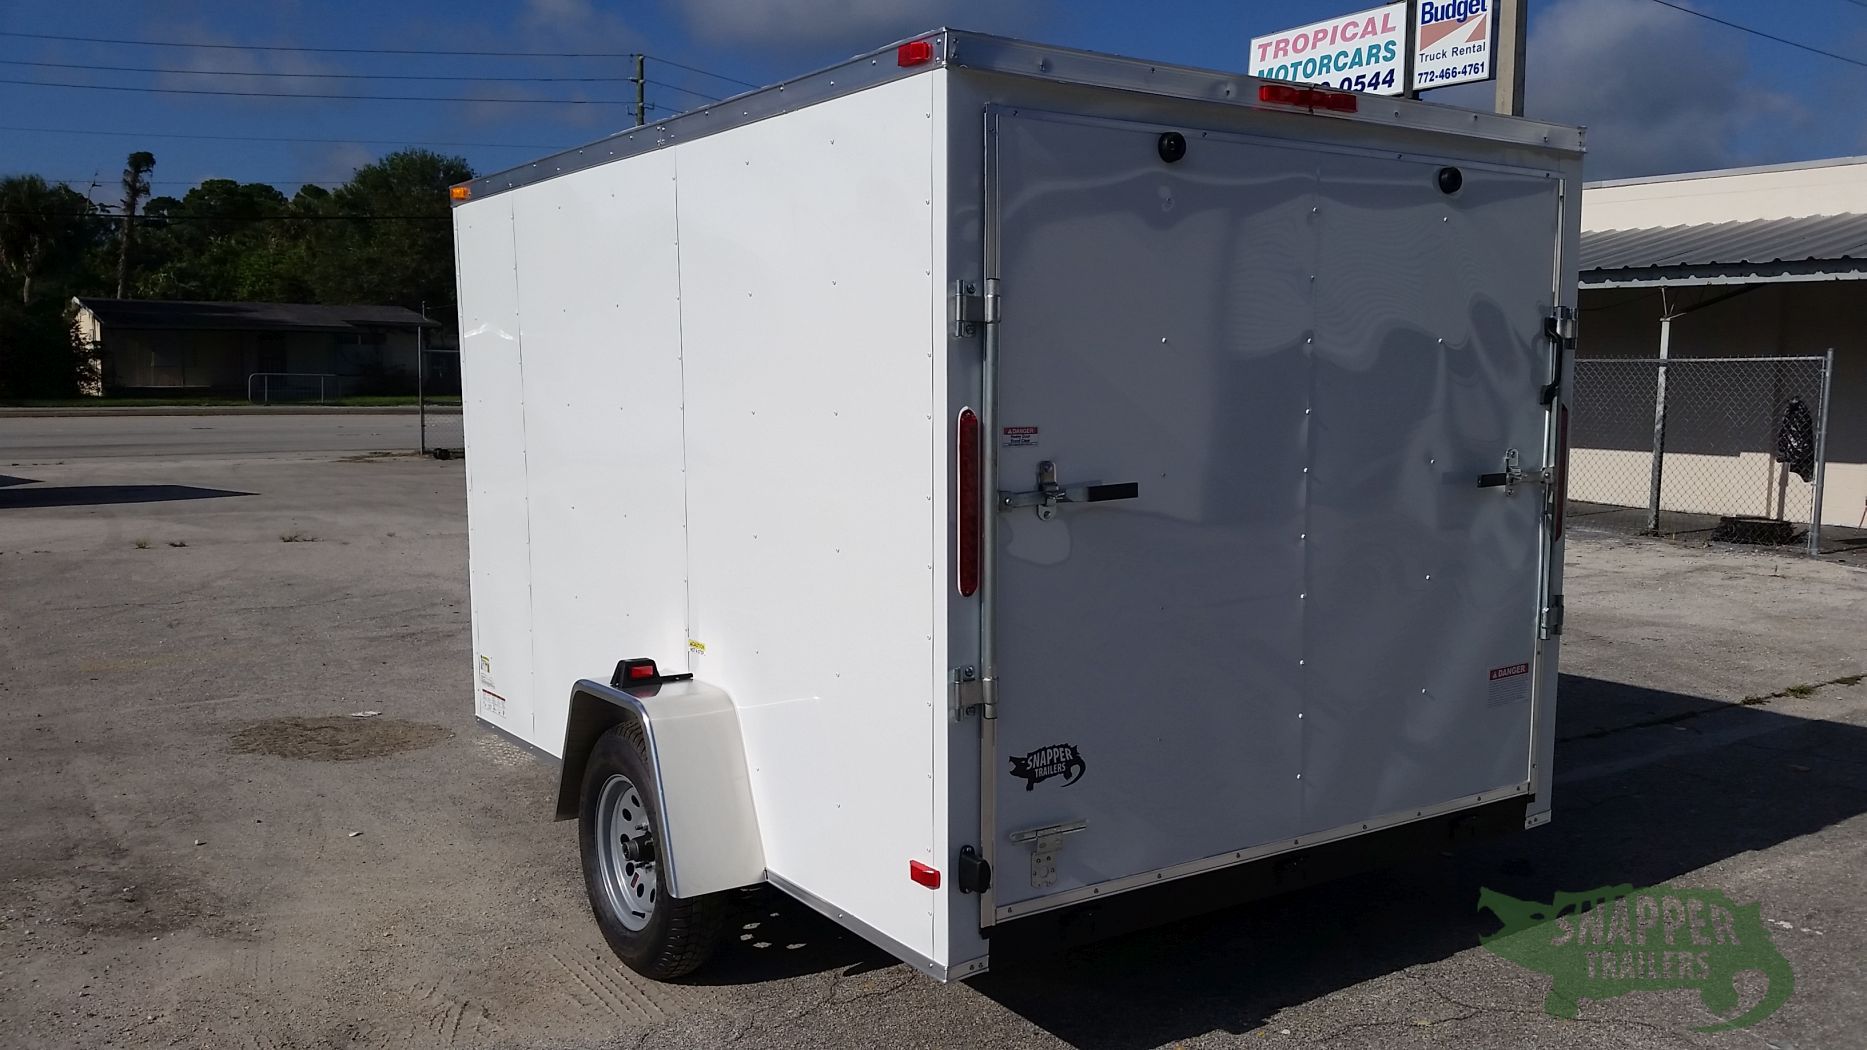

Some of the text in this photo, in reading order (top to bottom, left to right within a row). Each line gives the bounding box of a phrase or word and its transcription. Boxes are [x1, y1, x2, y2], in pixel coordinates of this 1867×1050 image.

[1257, 12, 1397, 63] TROPICAL
[1419, 41, 1486, 63] Truck Rental
[1417, 61, 1485, 84] 772-466-4761
[1499, 665, 1526, 677] DANGER
[1026, 747, 1073, 771] SNAPPER
[1034, 763, 1066, 778] TRAILERS
